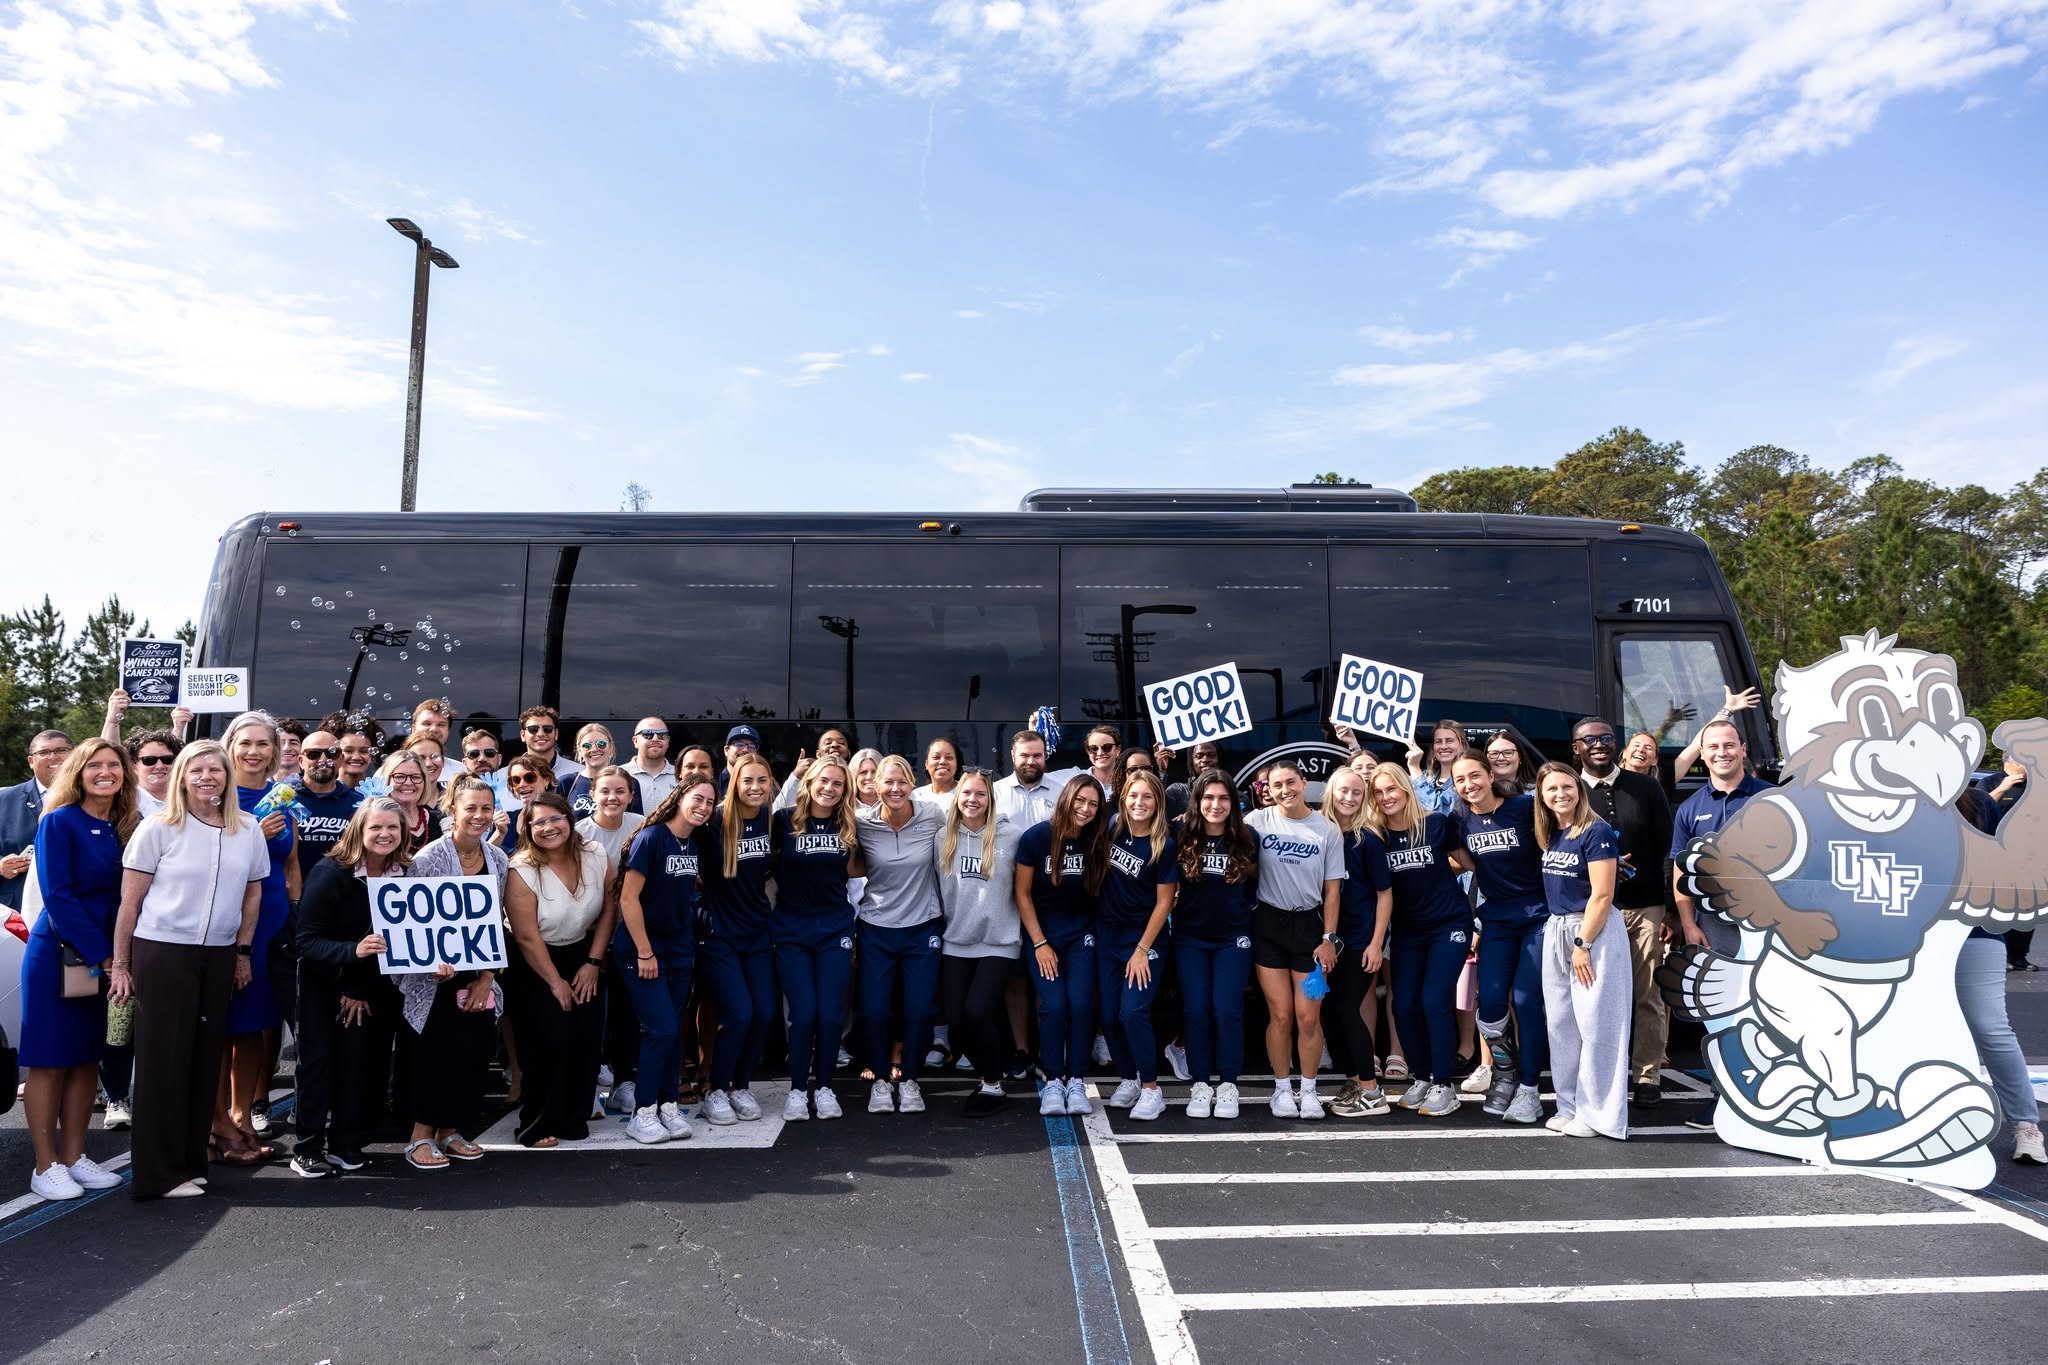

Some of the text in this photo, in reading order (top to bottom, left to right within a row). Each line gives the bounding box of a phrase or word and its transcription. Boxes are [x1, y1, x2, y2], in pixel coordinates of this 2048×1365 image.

[1633, 597, 1671, 613] 7101
[131, 647, 178, 658] Ospreys!
[126, 657, 179, 667] WINGS UP.
[125, 668, 179, 678] CANES DOWN.
[187, 674, 223, 682] SERVE IT
[1343, 660, 1416, 704] GOOD
[131, 692, 171, 702] Ospreys
[187, 689, 215, 697] SWOOP
[1152, 670, 1235, 716] GOOD
[1157, 699, 1246, 747] LUCK!
[1337, 692, 1413, 739] LUCK!
[1297, 757, 1331, 774] AST
[297, 816, 350, 834] sprey
[737, 836, 770, 855] PREYS
[796, 834, 845, 851] OSPREY
[1262, 834, 1320, 859] Ospreys
[1468, 829, 1518, 851] OSPREYS
[667, 856, 698, 872] OSPREY
[961, 856, 982, 874] UN
[1109, 845, 1142, 876] SPREYS
[1831, 843, 1919, 914] UNF
[377, 882, 493, 924] GOOD
[381, 923, 502, 968] LUCK!
